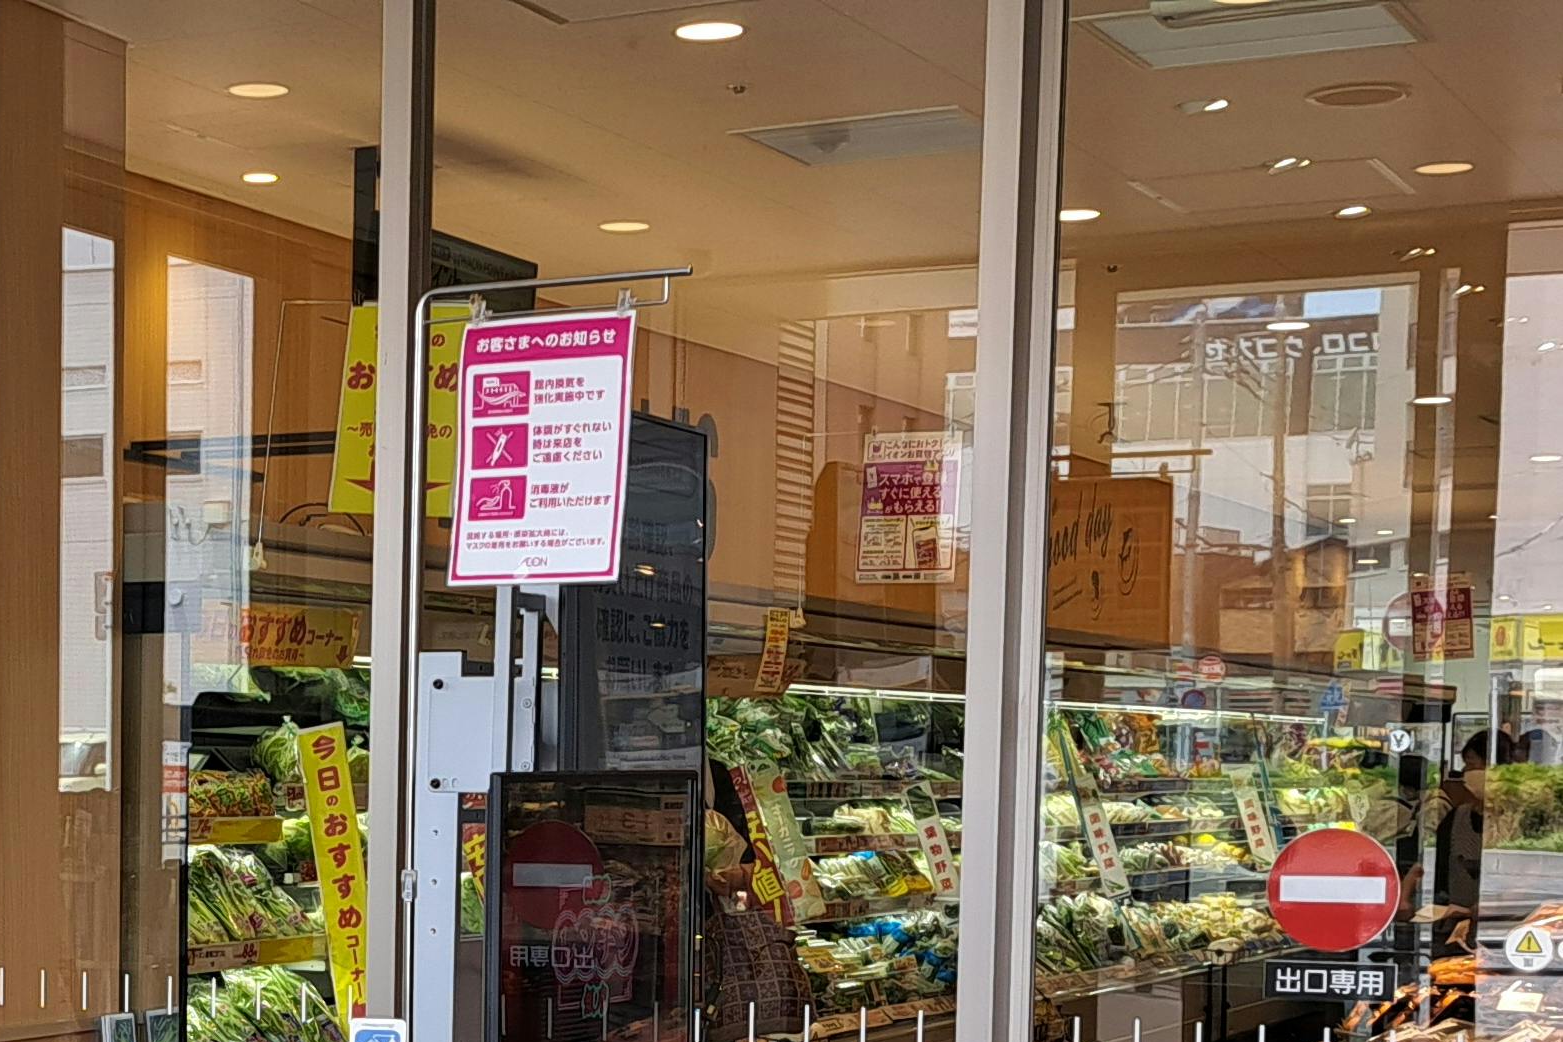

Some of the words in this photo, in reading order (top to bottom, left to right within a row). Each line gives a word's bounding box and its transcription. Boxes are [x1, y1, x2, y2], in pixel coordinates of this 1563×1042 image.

[475, 328, 618, 354] お客さまへのお知らせ
[311, 733, 366, 999] 今日のおすすめコーナー
[1275, 968, 1384, 996] 出口専用
